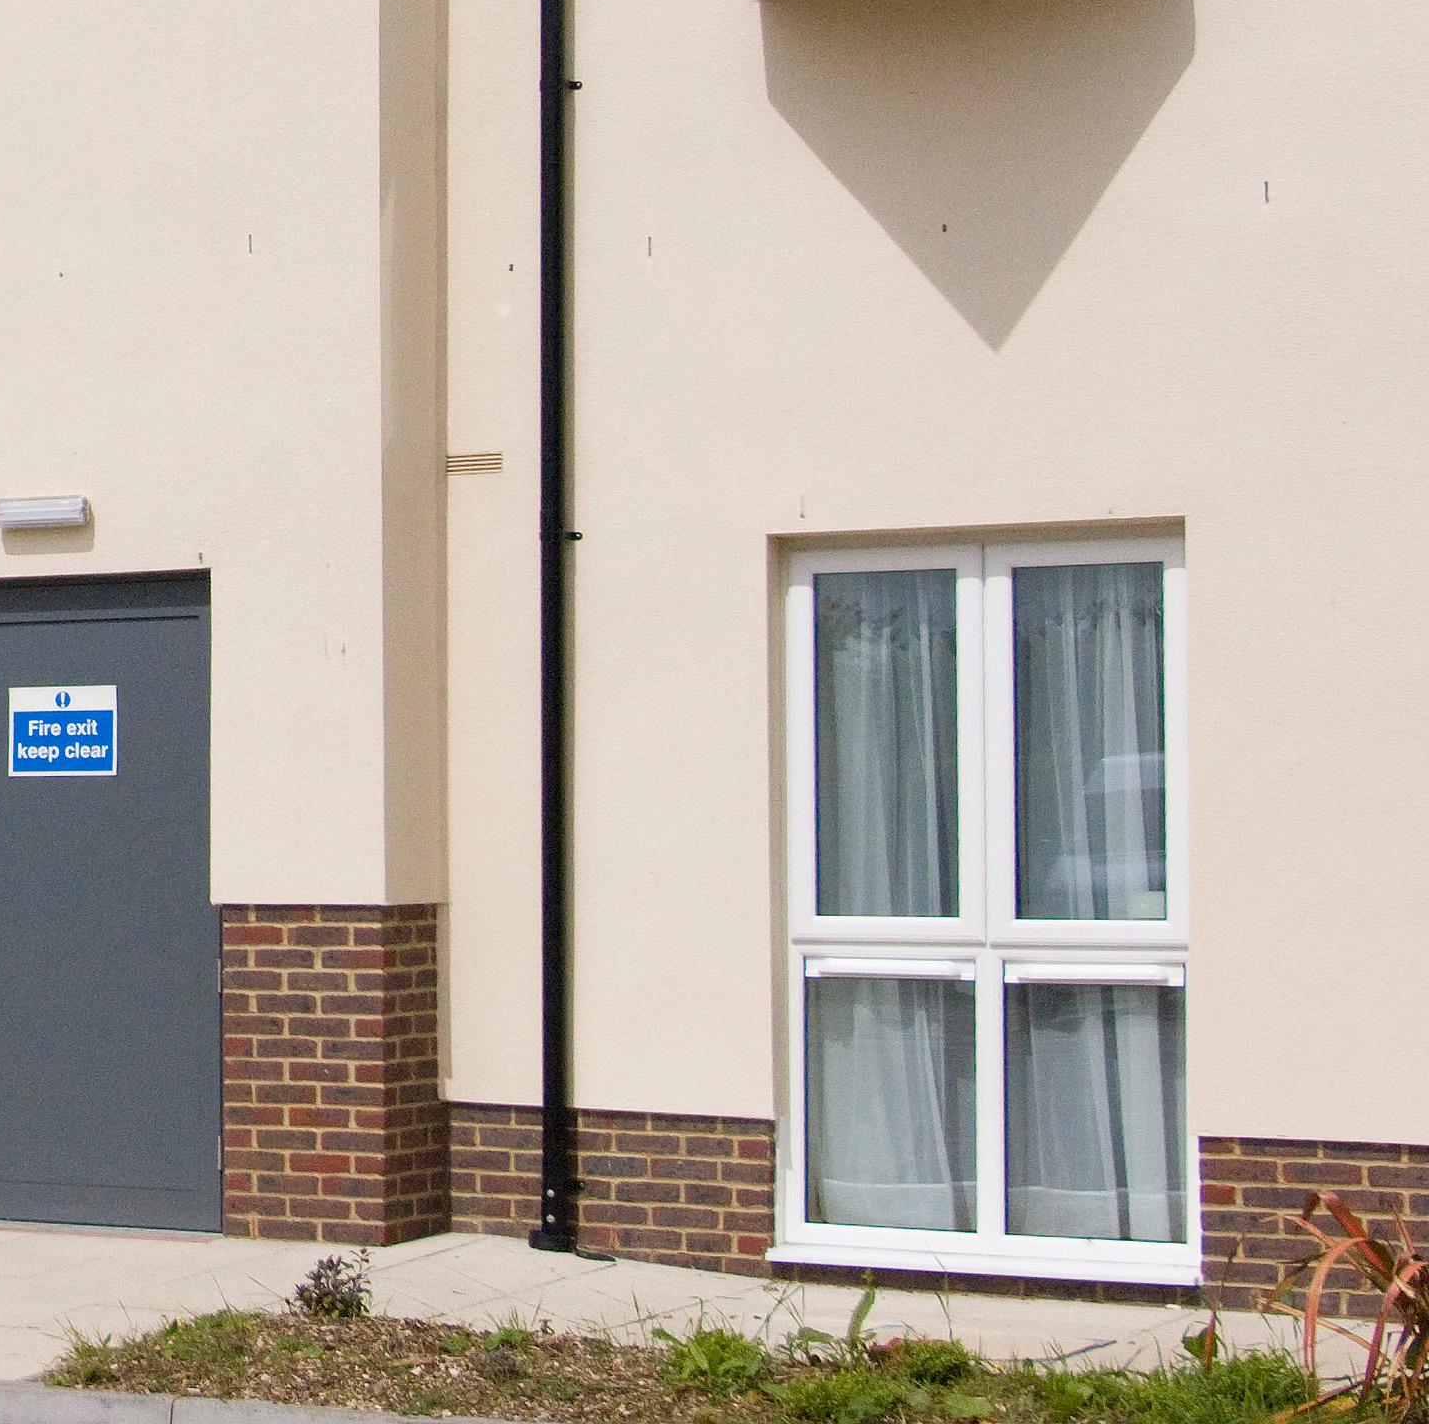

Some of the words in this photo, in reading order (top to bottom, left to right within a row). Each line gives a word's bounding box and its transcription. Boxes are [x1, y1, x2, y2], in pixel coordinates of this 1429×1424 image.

[28, 720, 61, 736] Fire
[66, 719, 98, 736] exit
[17, 743, 59, 762] keep
[64, 742, 109, 758] clear
